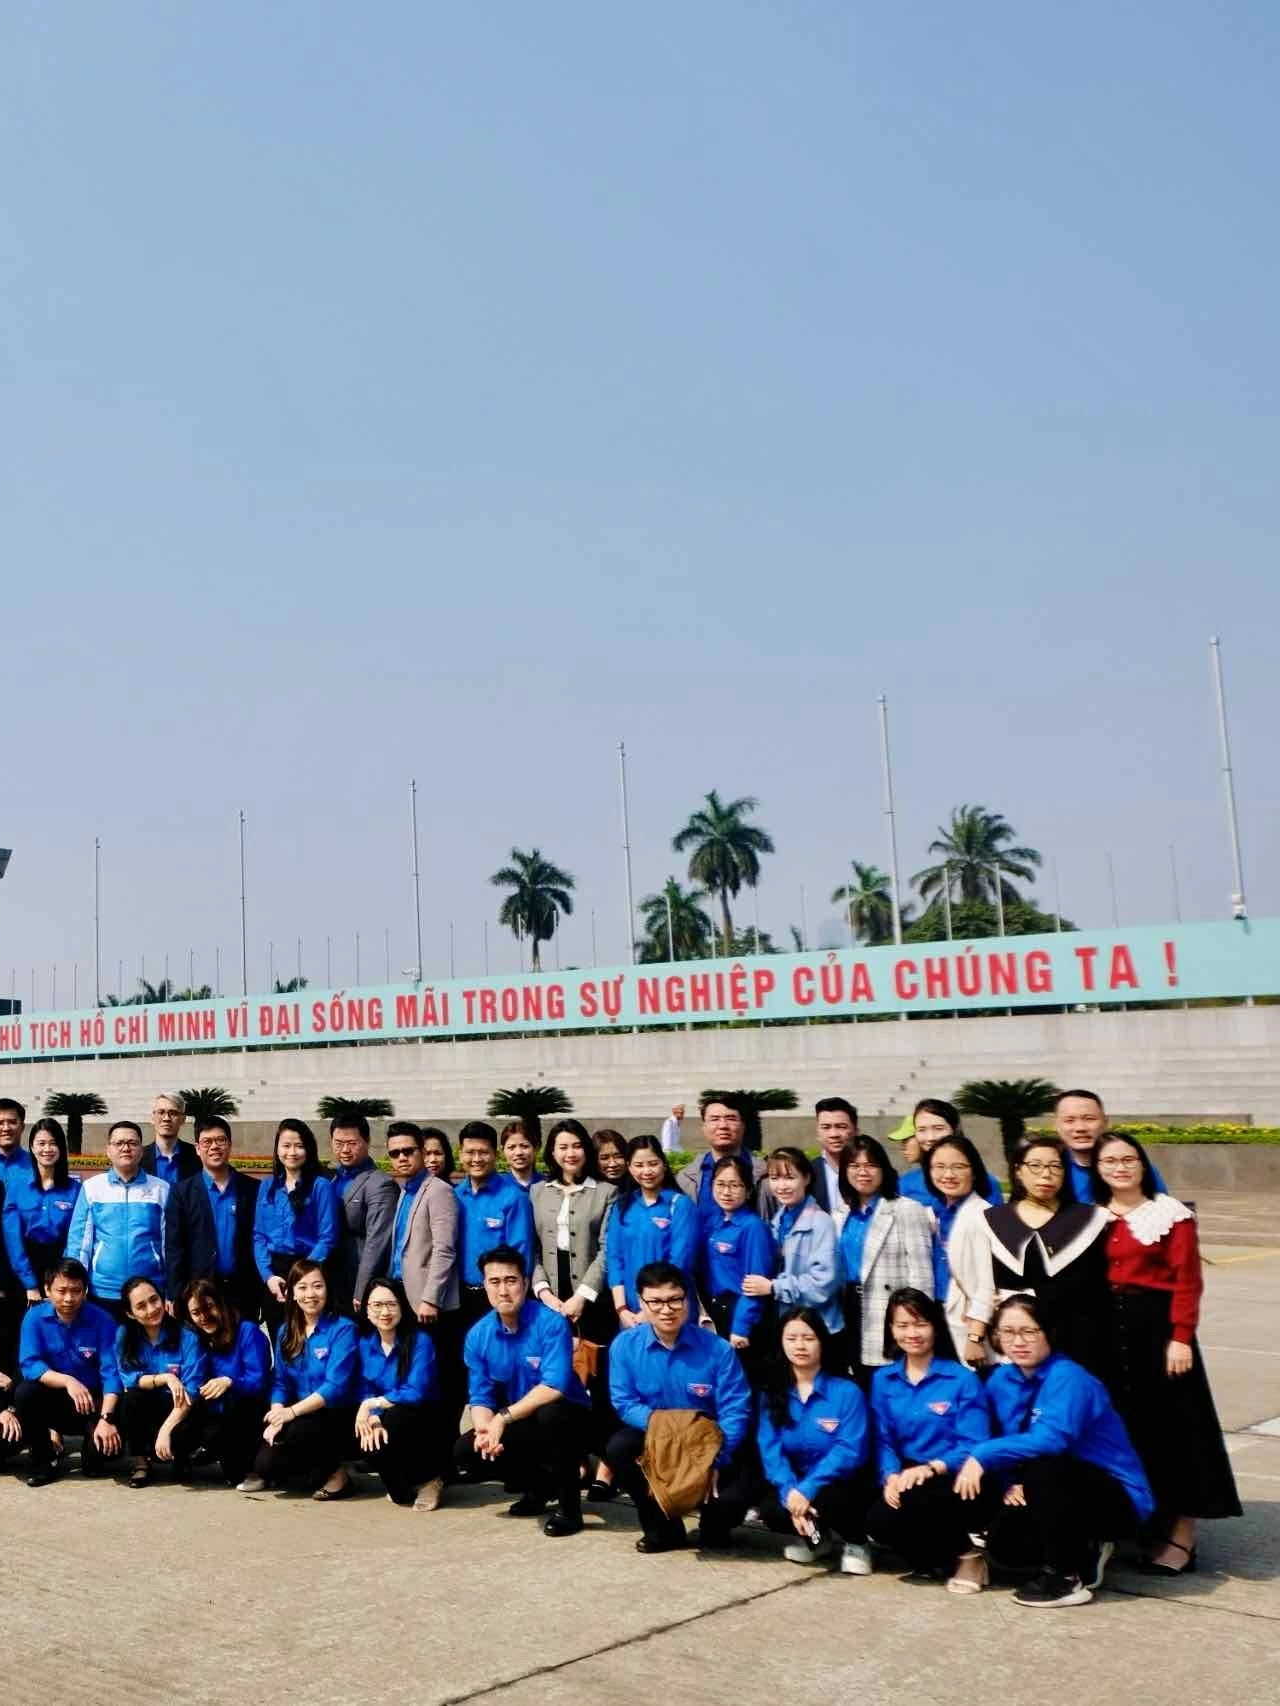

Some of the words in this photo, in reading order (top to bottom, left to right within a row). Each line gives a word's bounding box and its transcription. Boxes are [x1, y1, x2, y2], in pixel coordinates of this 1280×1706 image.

[30, 1020, 71, 1054] TỊCH
[80, 1009, 105, 1047] HỒ
[114, 1008, 148, 1044] CHÍ
[158, 1009, 216, 1042] MINH
[226, 1001, 248, 1039] VĨ
[259, 1003, 301, 1041] ĐẠI
[312, 990, 383, 1033] SỐNG
[395, 986, 449, 1029] MÃI
[462, 984, 565, 1024] TRONG
[579, 974, 624, 1024] SỰ
[637, 963, 775, 1016] NGHIỆP
[792, 951, 876, 1006] CỦA
[894, 945, 1053, 1000] CHÚNG
[1074, 944, 1139, 991] TA
